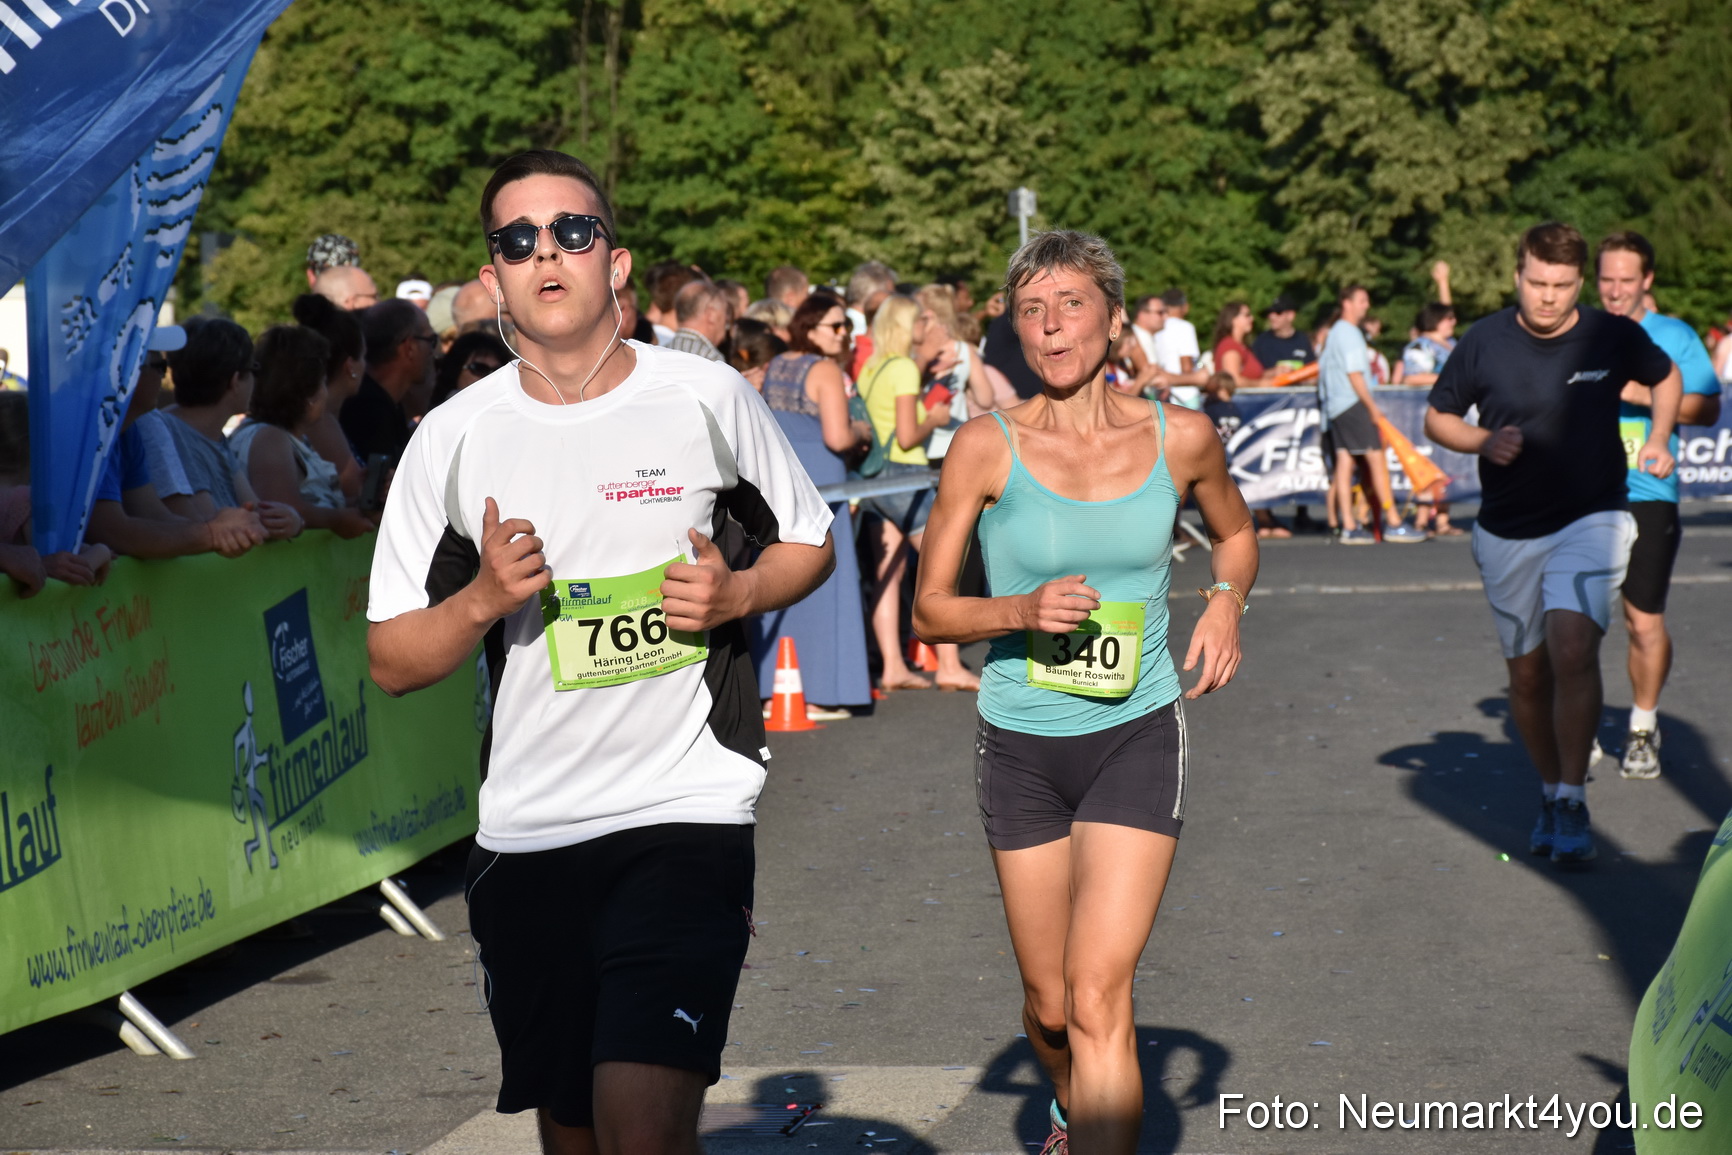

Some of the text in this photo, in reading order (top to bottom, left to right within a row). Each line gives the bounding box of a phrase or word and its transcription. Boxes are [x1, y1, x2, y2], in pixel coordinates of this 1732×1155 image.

[635, 468, 666, 478] TEAM
[597, 480, 657, 493] guttenberger
[617, 486, 684, 502] partner
[640, 496, 682, 505] LICHTWERBUNG
[561, 594, 612, 606] firmenlauf
[620, 596, 648, 610] 2018
[577, 607, 669, 657] 766
[279, 637, 309, 672] Fischer
[593, 647, 665, 668] Häring Leon
[1051, 633, 1120, 670] 340
[577, 664, 628, 680] guttenberger
[630, 660, 657, 673] partner
[659, 651, 683, 663] GmbH
[1045, 665, 1125, 681] Bäumler Roswitha
[268, 679, 368, 822] firmenlauf
[0, 764, 61, 885] lauf
